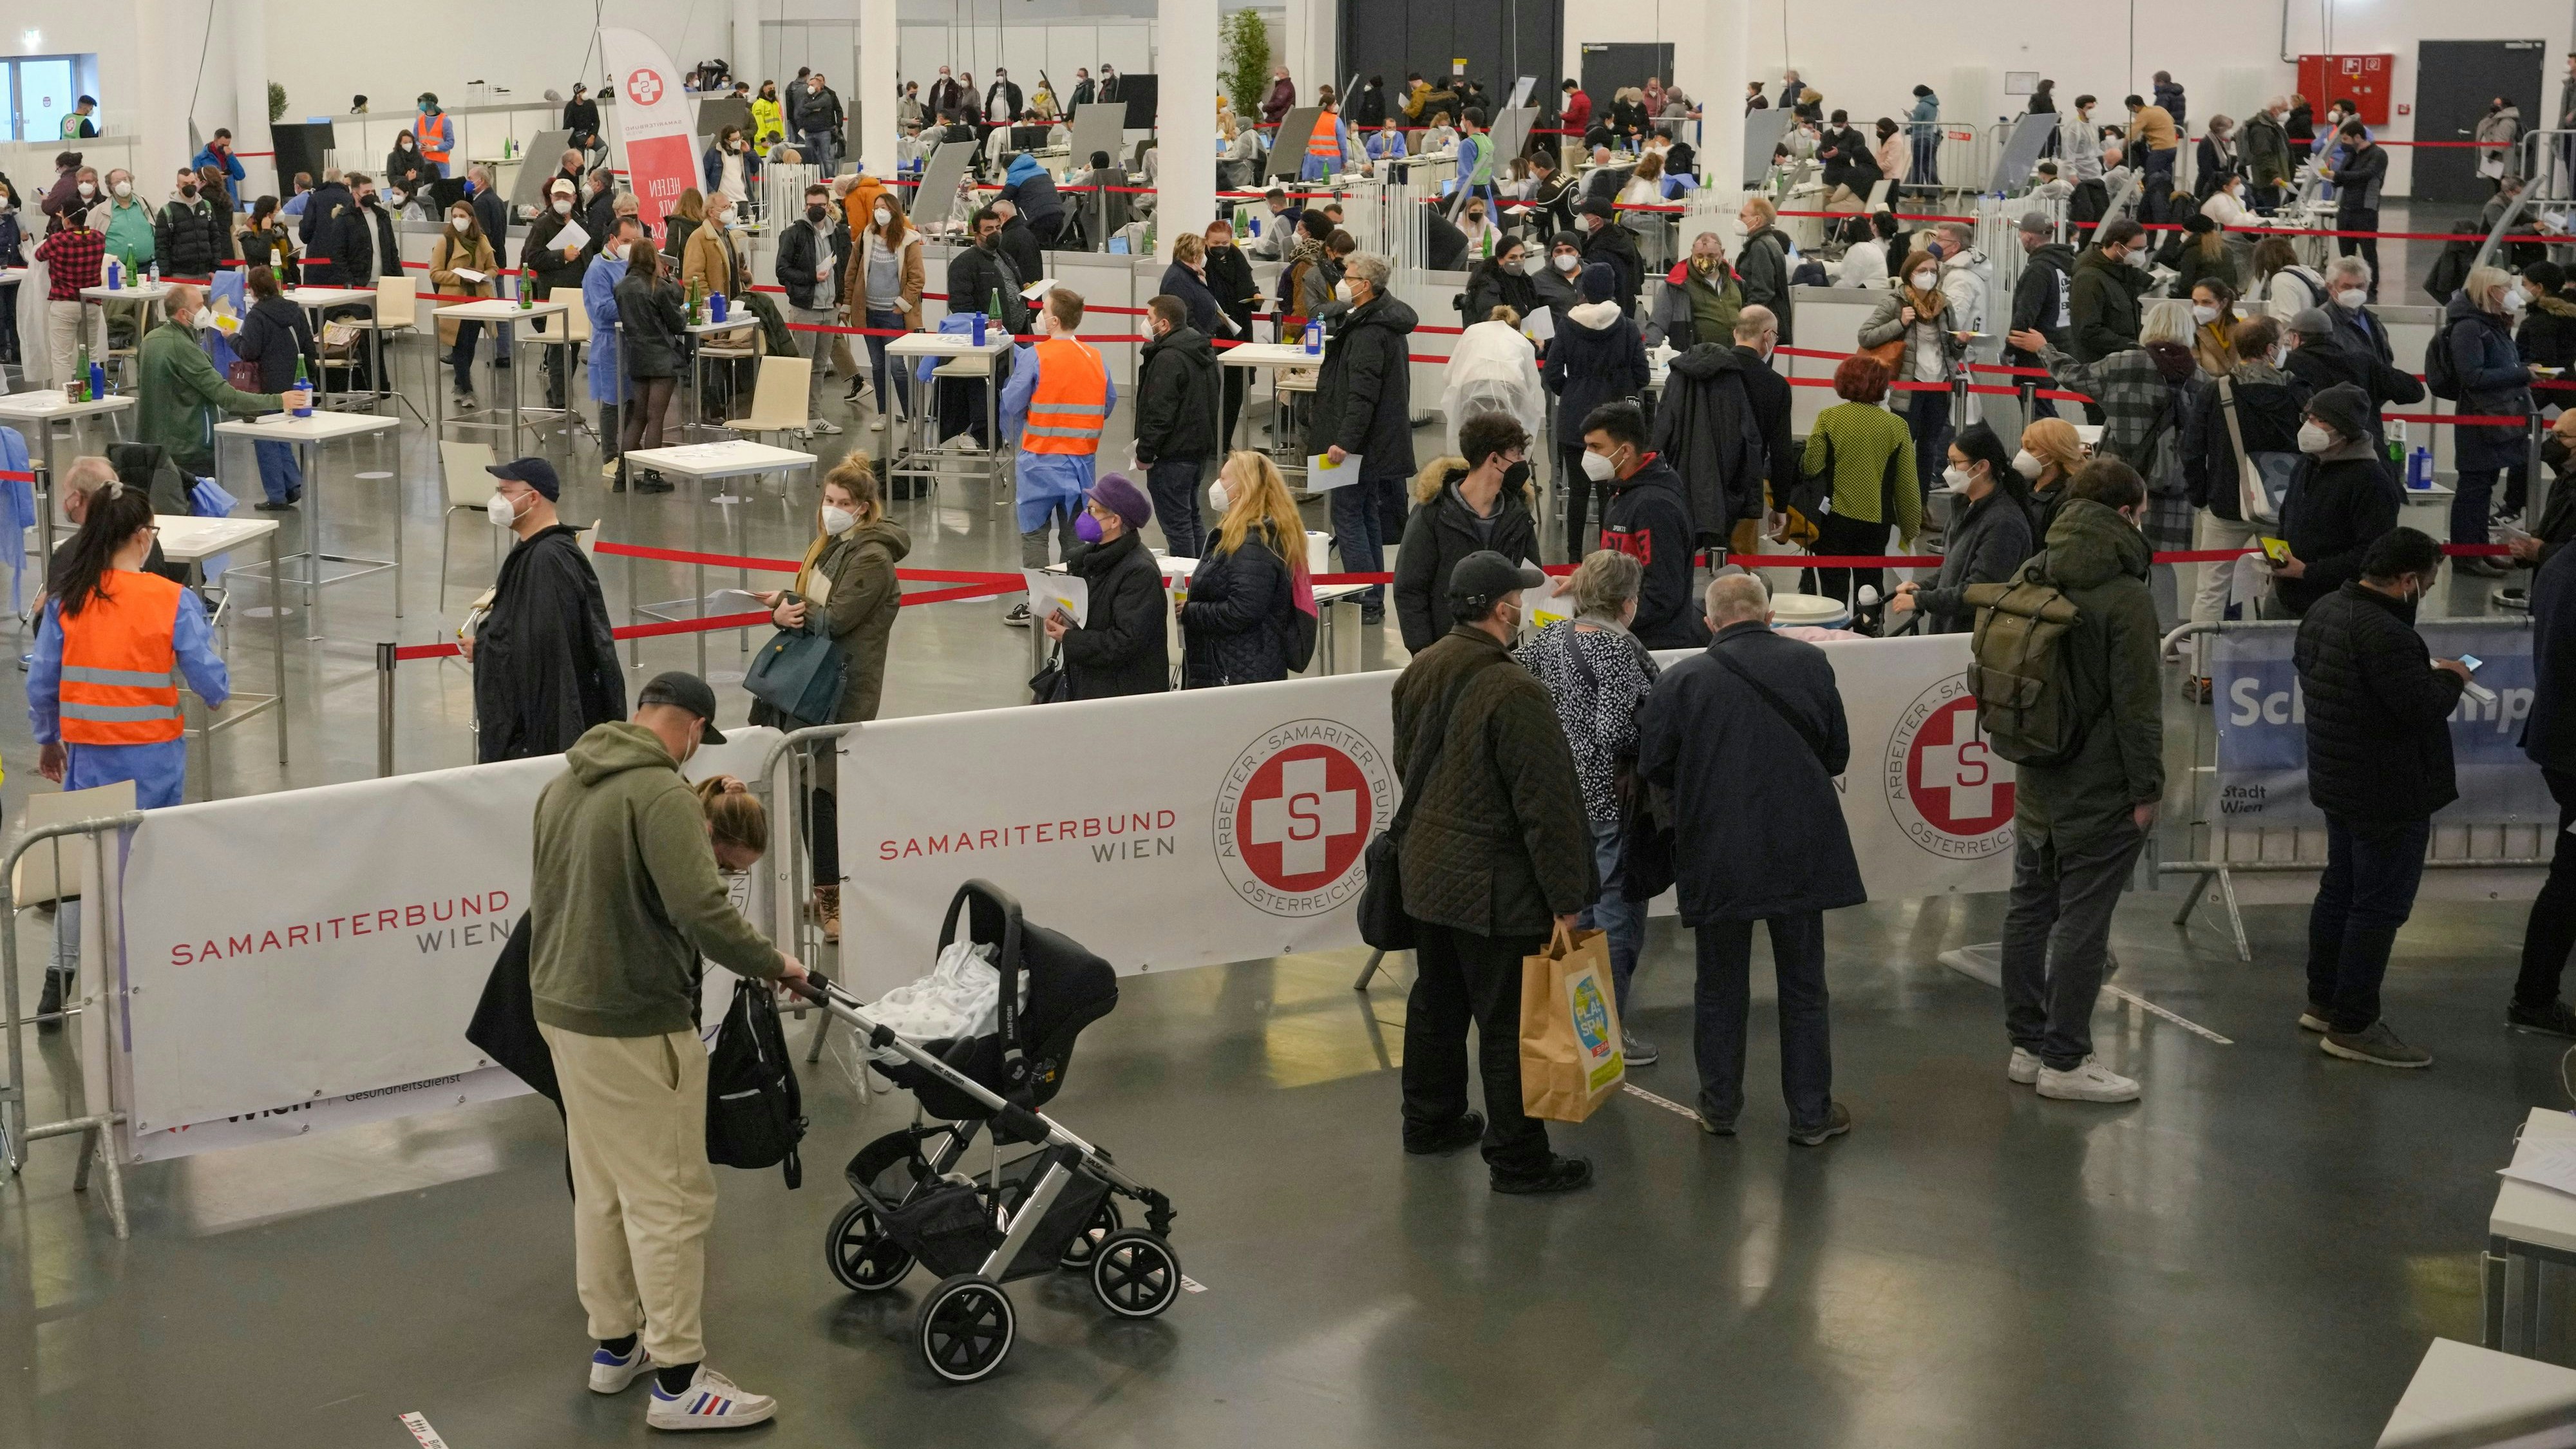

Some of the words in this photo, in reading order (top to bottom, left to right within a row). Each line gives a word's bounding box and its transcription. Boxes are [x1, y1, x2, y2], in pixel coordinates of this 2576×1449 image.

[1269, 726, 1373, 766] SAMARITER
[1889, 703, 1929, 799] ARBEITER
[1956, 741, 1989, 786] S
[1219, 755, 1257, 858] ARBEITER
[2221, 800, 2262, 813] Wien
[2222, 785, 2266, 799] Stadt
[880, 810, 1176, 860] SAMARITERBUND
[1289, 793, 1320, 841] S
[1092, 836, 1175, 863] WIEN
[1243, 867, 1365, 911] ÖSTERREICHS
[171, 891, 509, 965] SAMARITERBUND
[416, 919, 509, 953] WIEN
